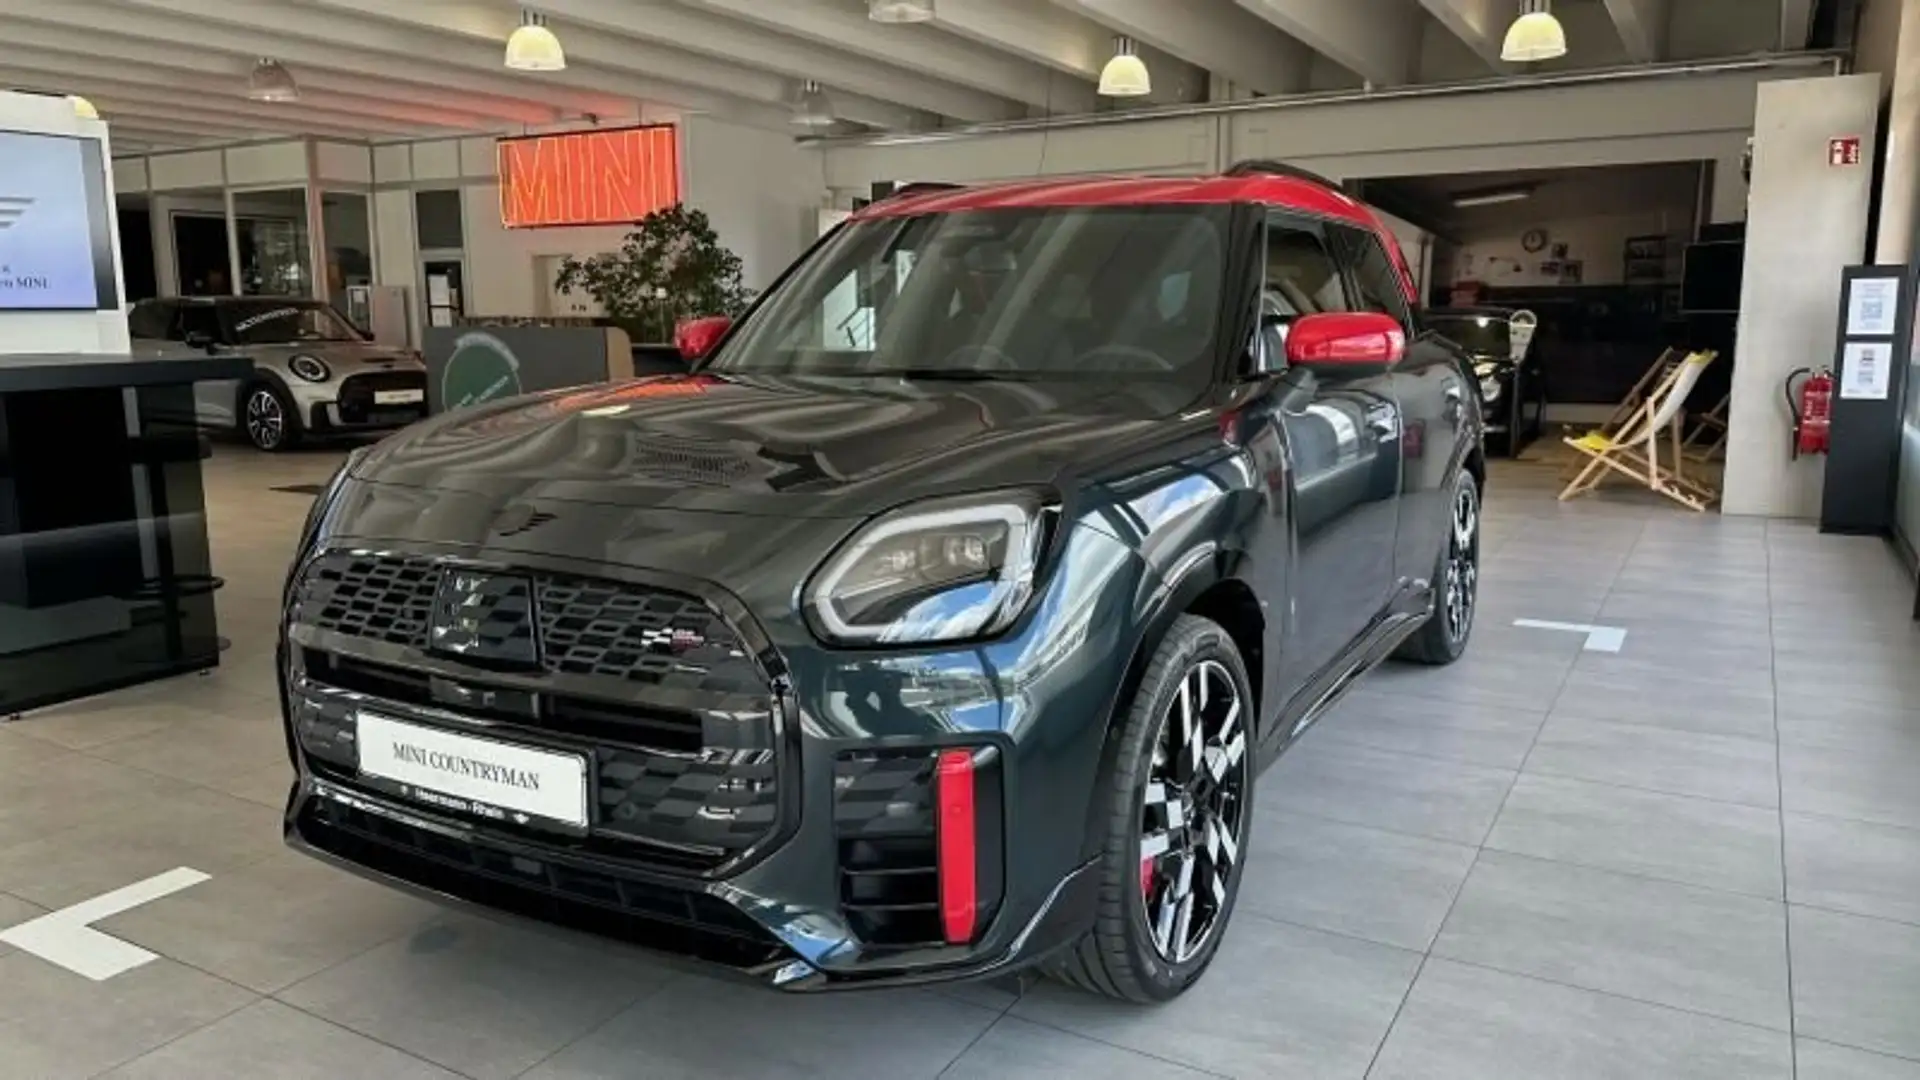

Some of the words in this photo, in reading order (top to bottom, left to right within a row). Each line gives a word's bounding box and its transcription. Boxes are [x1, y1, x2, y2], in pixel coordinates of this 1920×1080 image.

[497, 127, 676, 226] MINI
[392, 741, 428, 767] MINI
[429, 751, 540, 789] COUNTRYMAN
